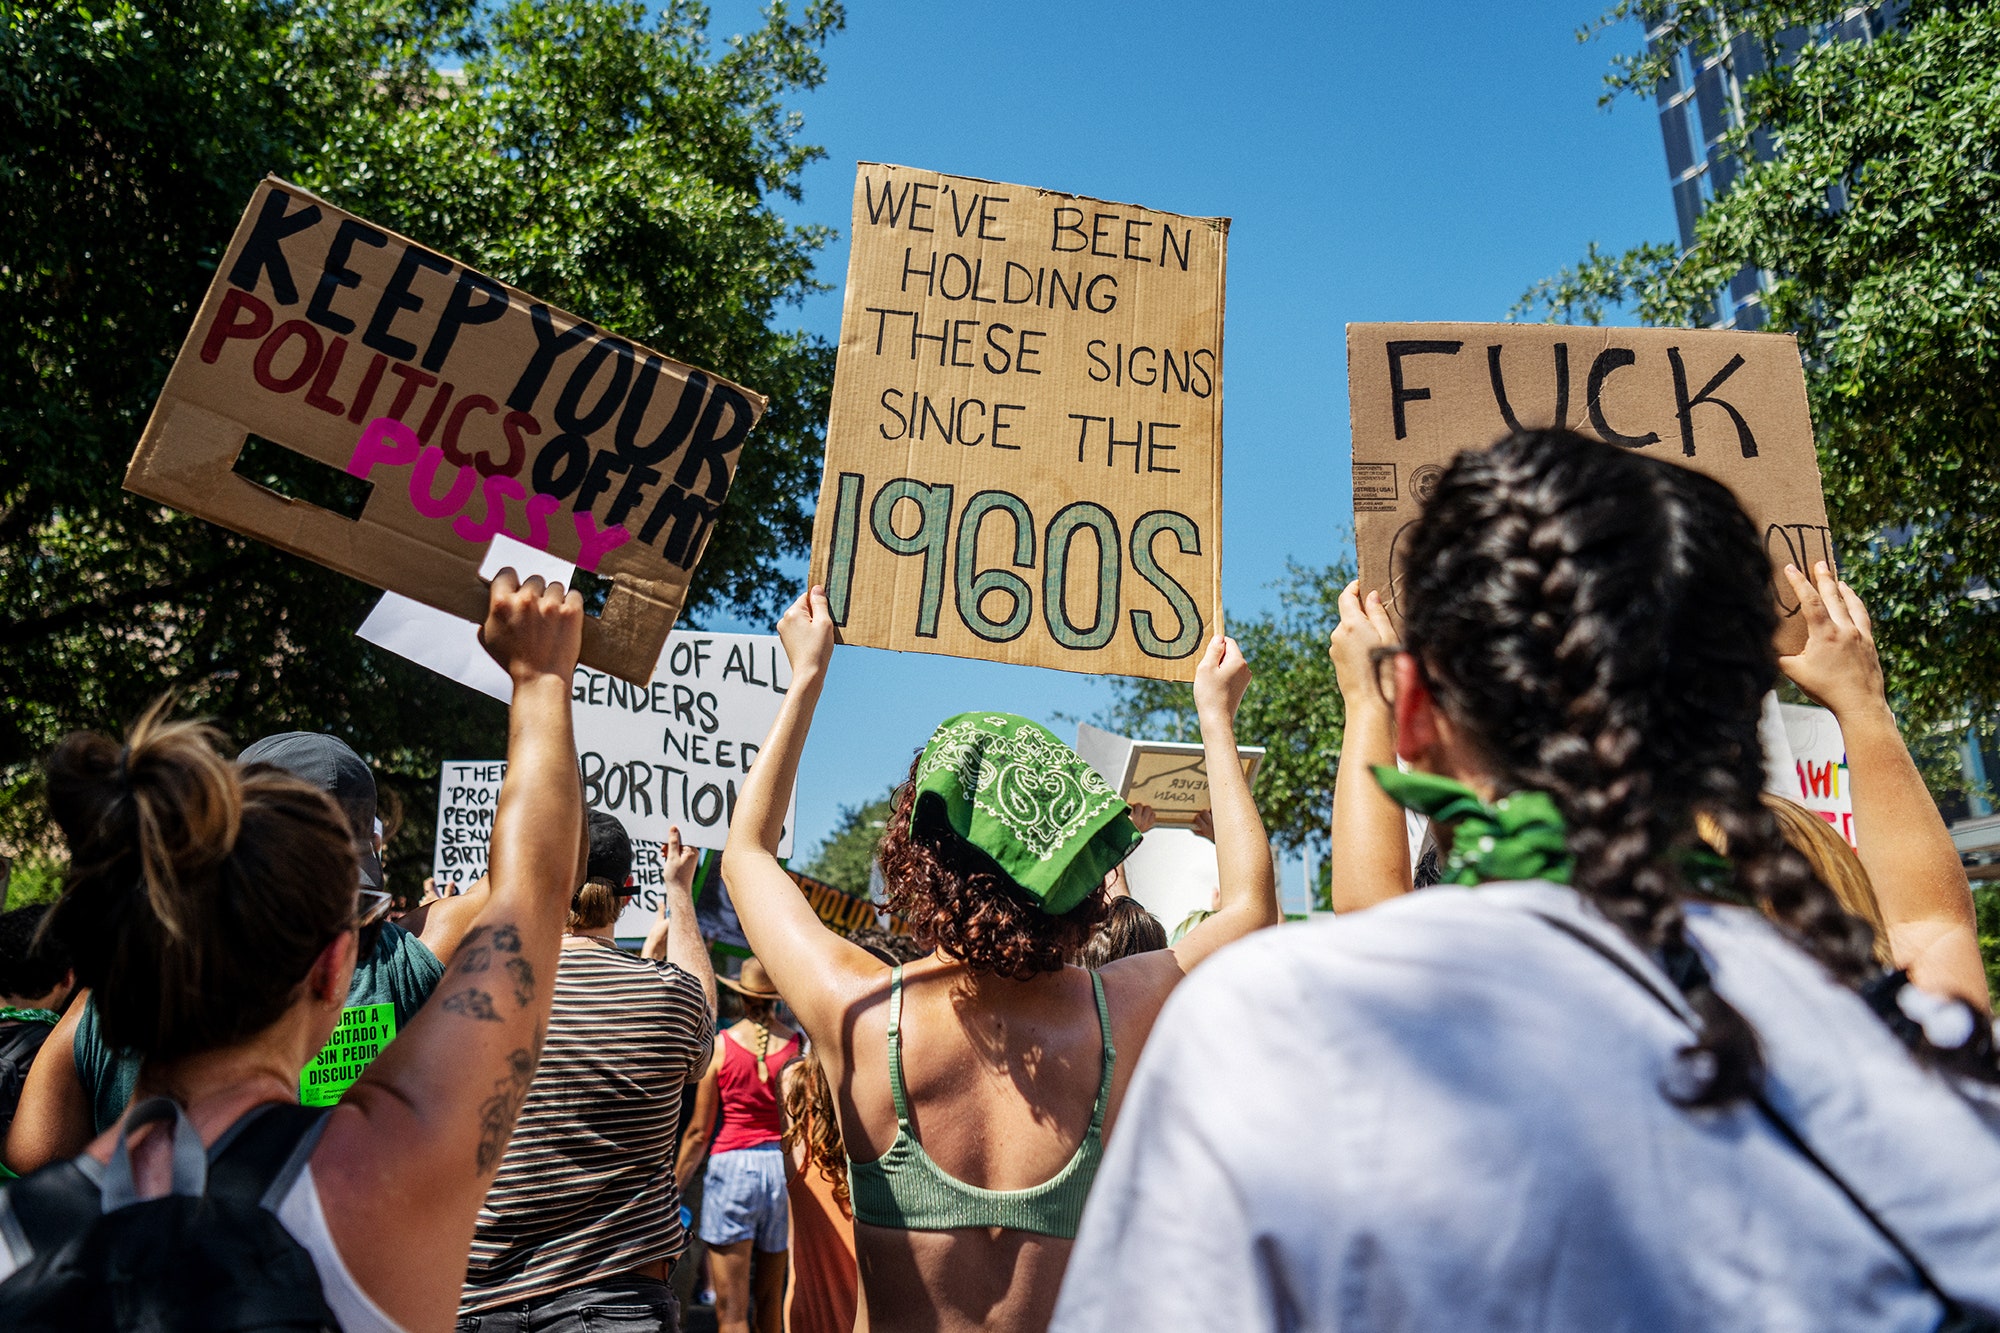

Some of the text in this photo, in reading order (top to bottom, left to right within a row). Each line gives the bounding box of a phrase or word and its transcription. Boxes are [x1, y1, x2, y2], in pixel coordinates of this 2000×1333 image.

[865, 175, 1192, 271] WE'VE BEEN
[901, 247, 1119, 314] HOLDING
[226, 189, 754, 503] KEEP YOUR
[865, 307, 1216, 399] THESE SIGNS
[200, 288, 723, 572] POLITICS OFF MY
[879, 387, 1182, 474] SINCE THE
[1385, 340, 1760, 459] FUCK
[347, 417, 631, 572] PUSSY
[825, 471, 1203, 660] 1960S
[571, 667, 720, 734] GENDERS
[670, 640, 788, 695] OF ALL
[663, 728, 760, 774] NEED
[581, 751, 786, 842] BORTIO
[437, 868, 464, 883] TO
[317, 1044, 379, 1066] SIN PEDIR
[325, 1024, 389, 1047] CITADO Y
[371, 1008, 379, 1023] A
